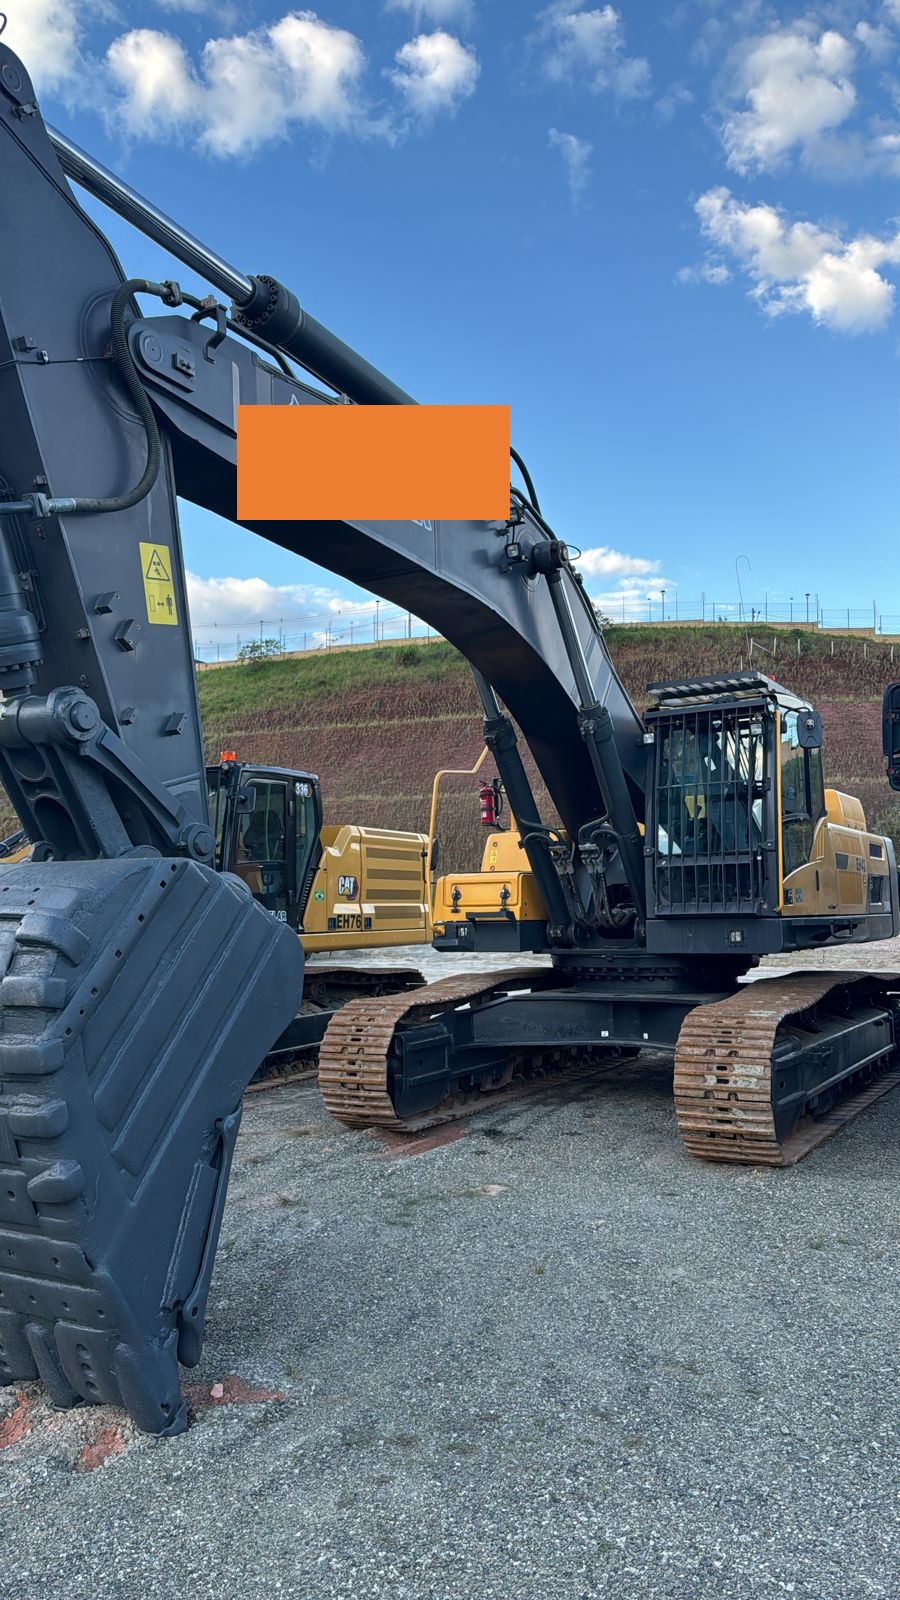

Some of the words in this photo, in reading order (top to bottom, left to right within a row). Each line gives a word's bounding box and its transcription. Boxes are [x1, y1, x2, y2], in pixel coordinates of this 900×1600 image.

[295, 781, 308, 797] 336
[338, 875, 355, 896] CAT
[336, 913, 362, 930] EH76
